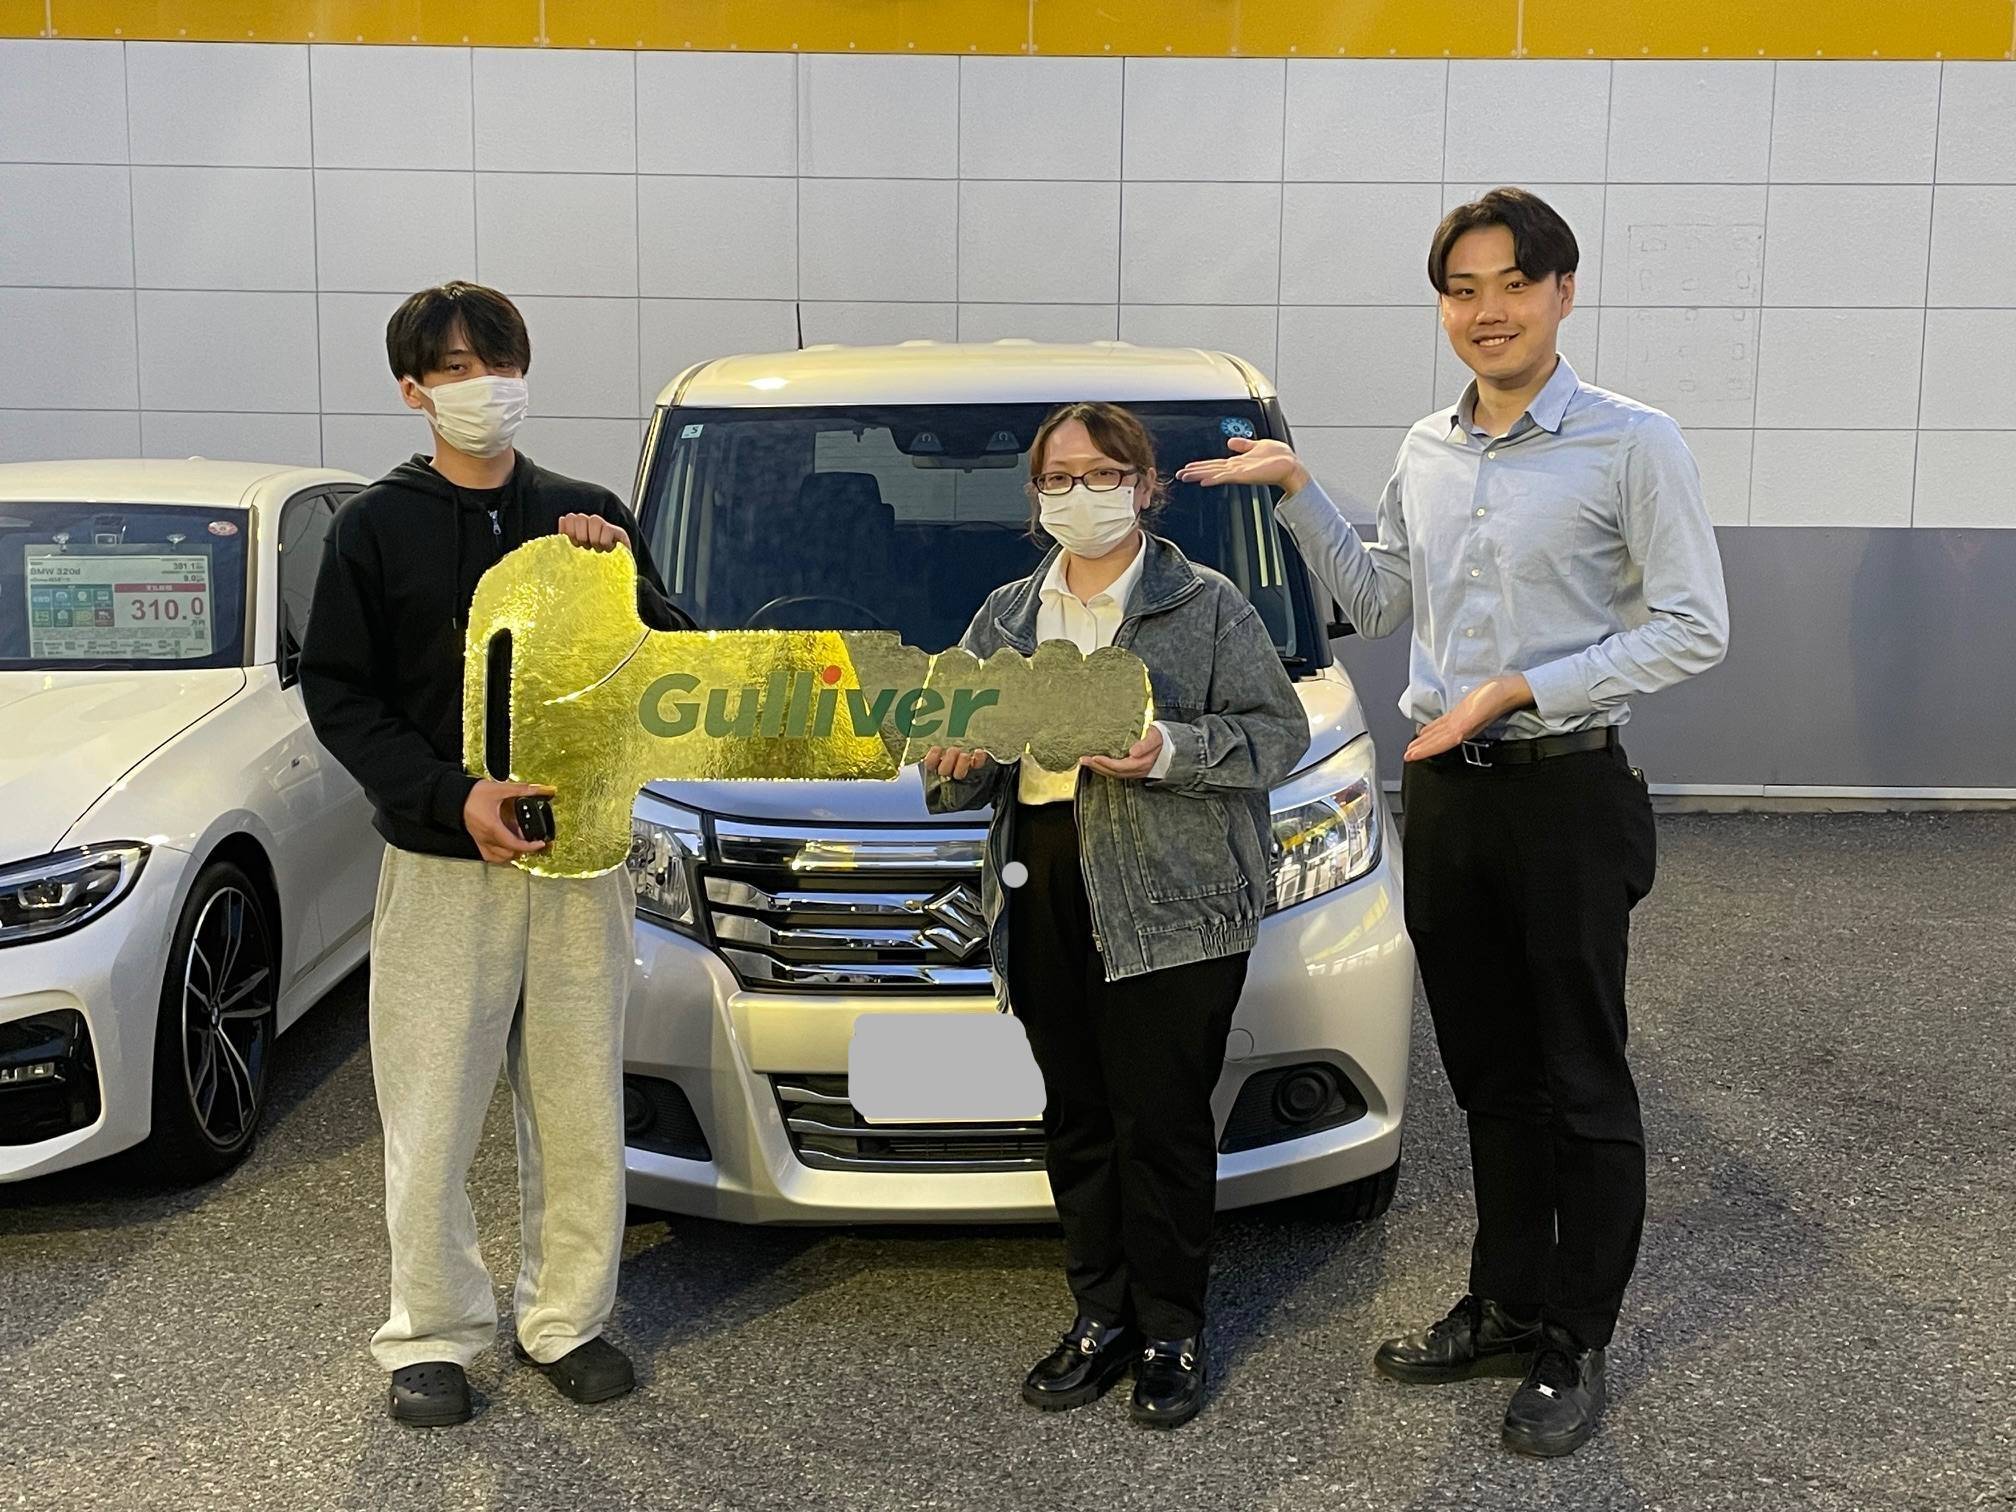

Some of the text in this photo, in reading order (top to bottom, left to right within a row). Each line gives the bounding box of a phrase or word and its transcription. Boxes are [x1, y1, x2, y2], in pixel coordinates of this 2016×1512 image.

[56, 567, 81, 575] 320d
[131, 597, 204, 620] 310.0
[638, 665, 1000, 738] Gulliver
